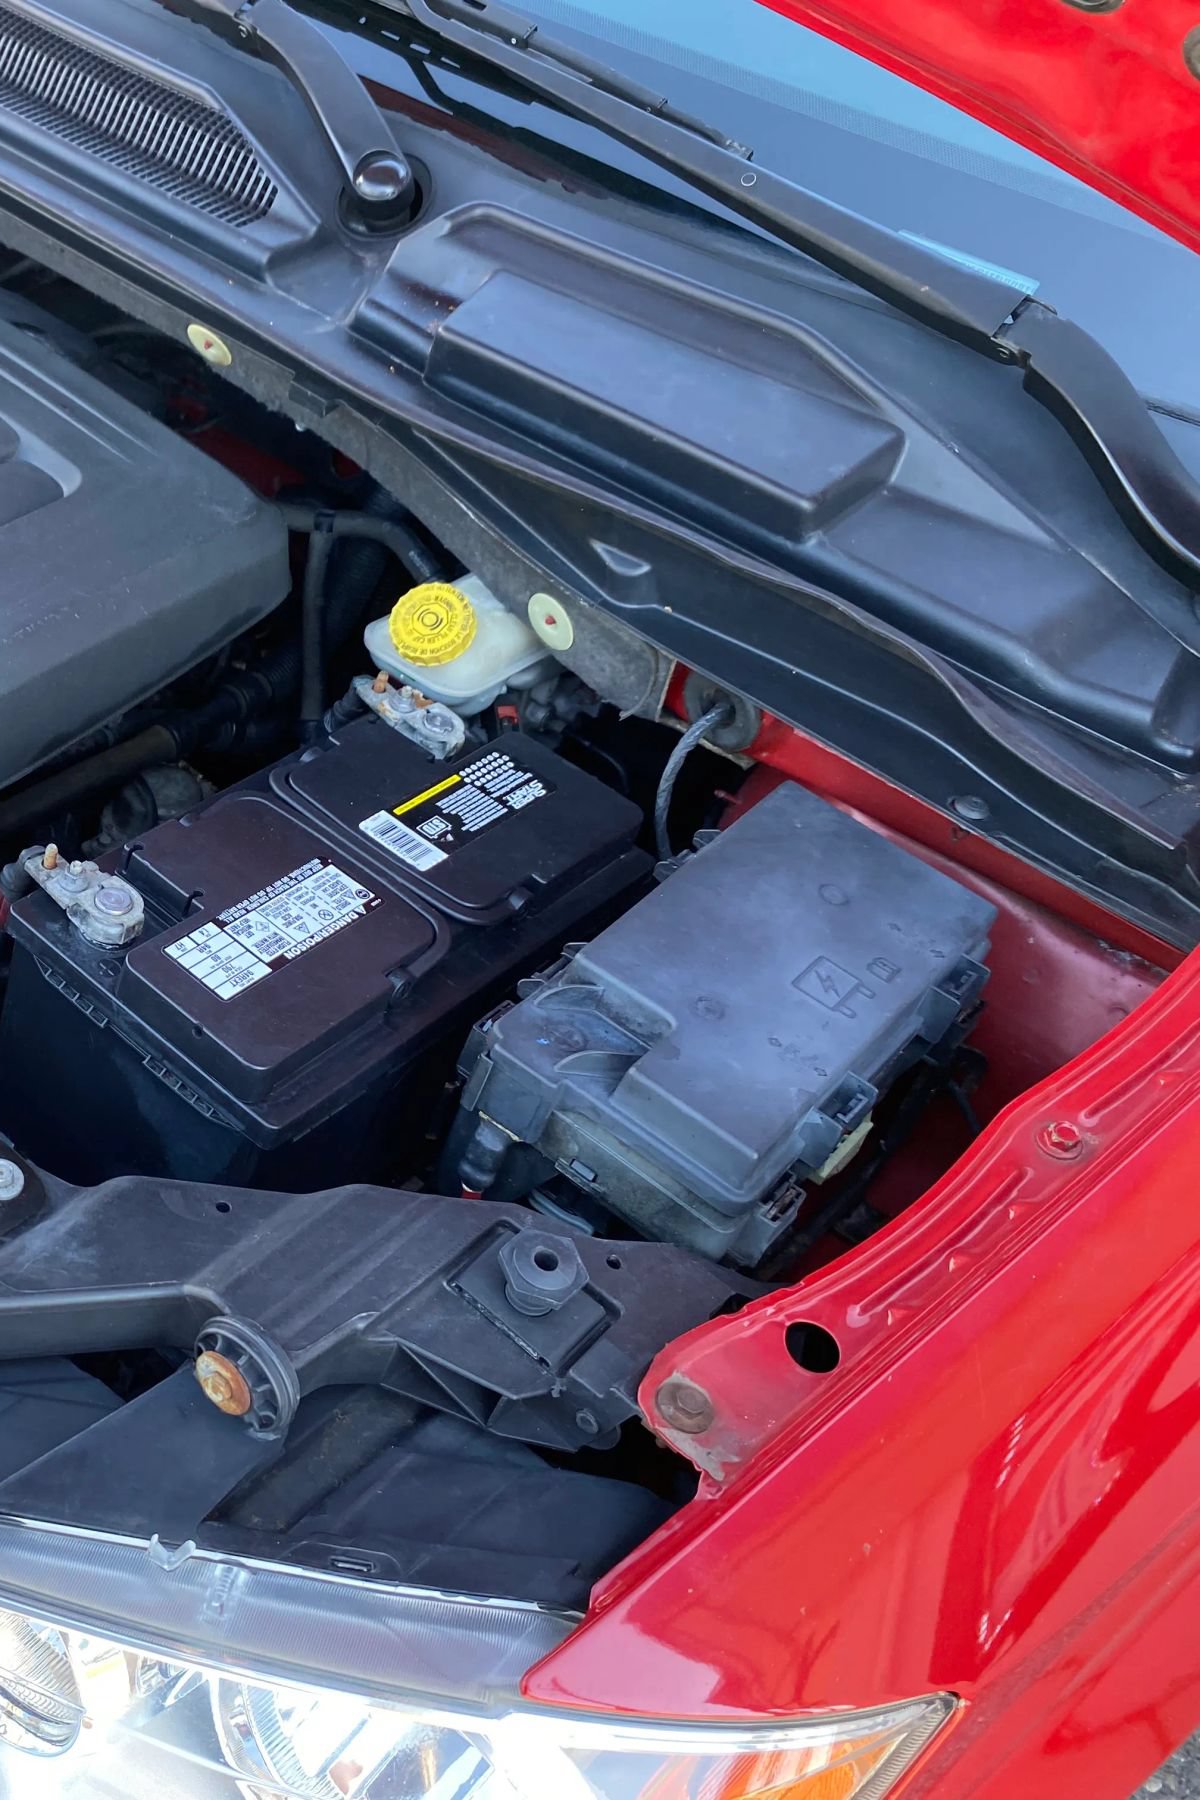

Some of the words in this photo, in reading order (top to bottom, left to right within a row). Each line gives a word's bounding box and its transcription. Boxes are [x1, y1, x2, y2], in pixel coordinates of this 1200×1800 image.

[509, 786, 548, 810] SUPER
[281, 910, 359, 959] DANGER/POISON
[220, 962, 236, 973] 790
[226, 969, 255, 987] 94REXT
